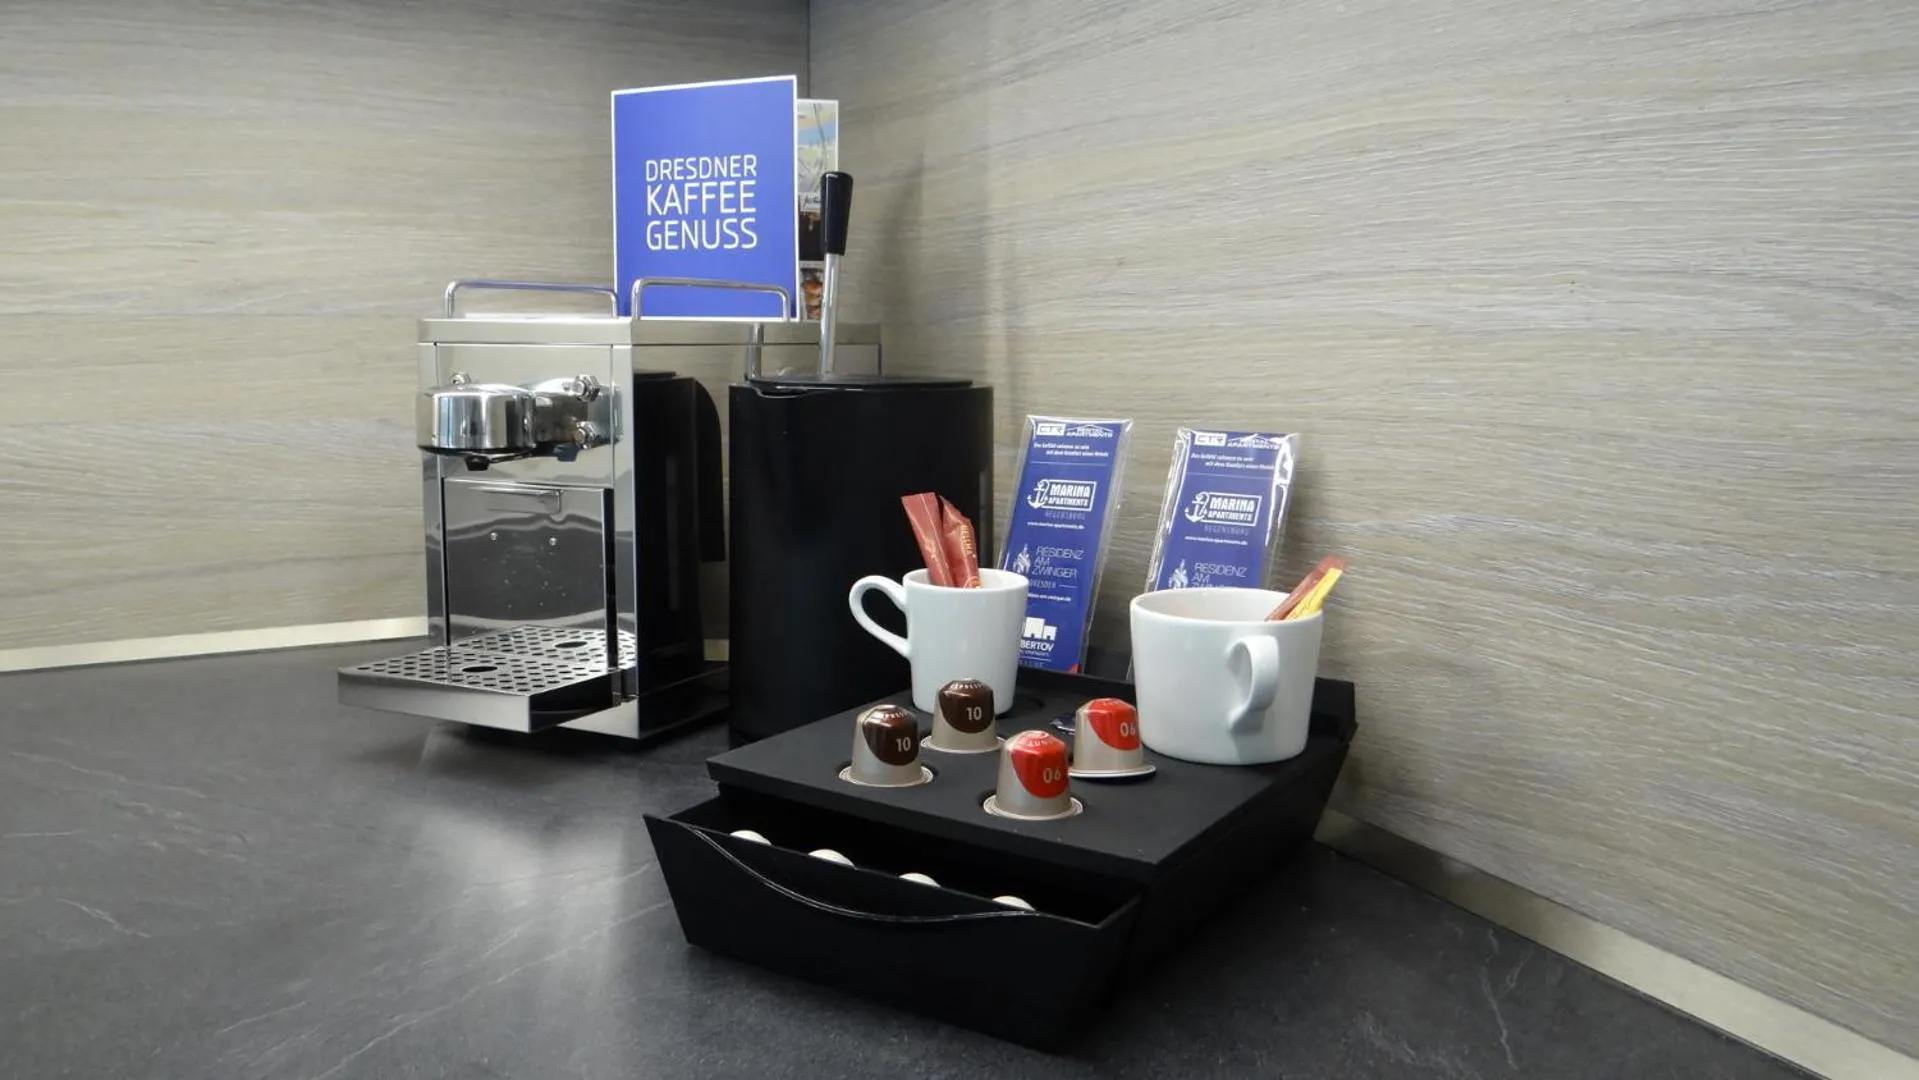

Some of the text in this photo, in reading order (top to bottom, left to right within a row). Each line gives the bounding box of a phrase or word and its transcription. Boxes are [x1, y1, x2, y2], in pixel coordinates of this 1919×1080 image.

[646, 154, 757, 181] DRESDNER
[647, 180, 757, 216] KAFFEE
[646, 217, 758, 250] GENUSS
[1050, 484, 1091, 498] MARINA
[1209, 497, 1255, 512] MARINA
[1036, 545, 1084, 560] RESIDENZ
[1034, 557, 1050, 567] AM
[1031, 566, 1079, 578] ZWINGER
[1195, 562, 1248, 578] RESIDENZ
[1191, 573, 1210, 583] AM
[1020, 640, 1055, 653] BERTOV
[966, 707, 982, 721] 10
[896, 737, 912, 752] 10
[1043, 768, 1062, 784] 06
